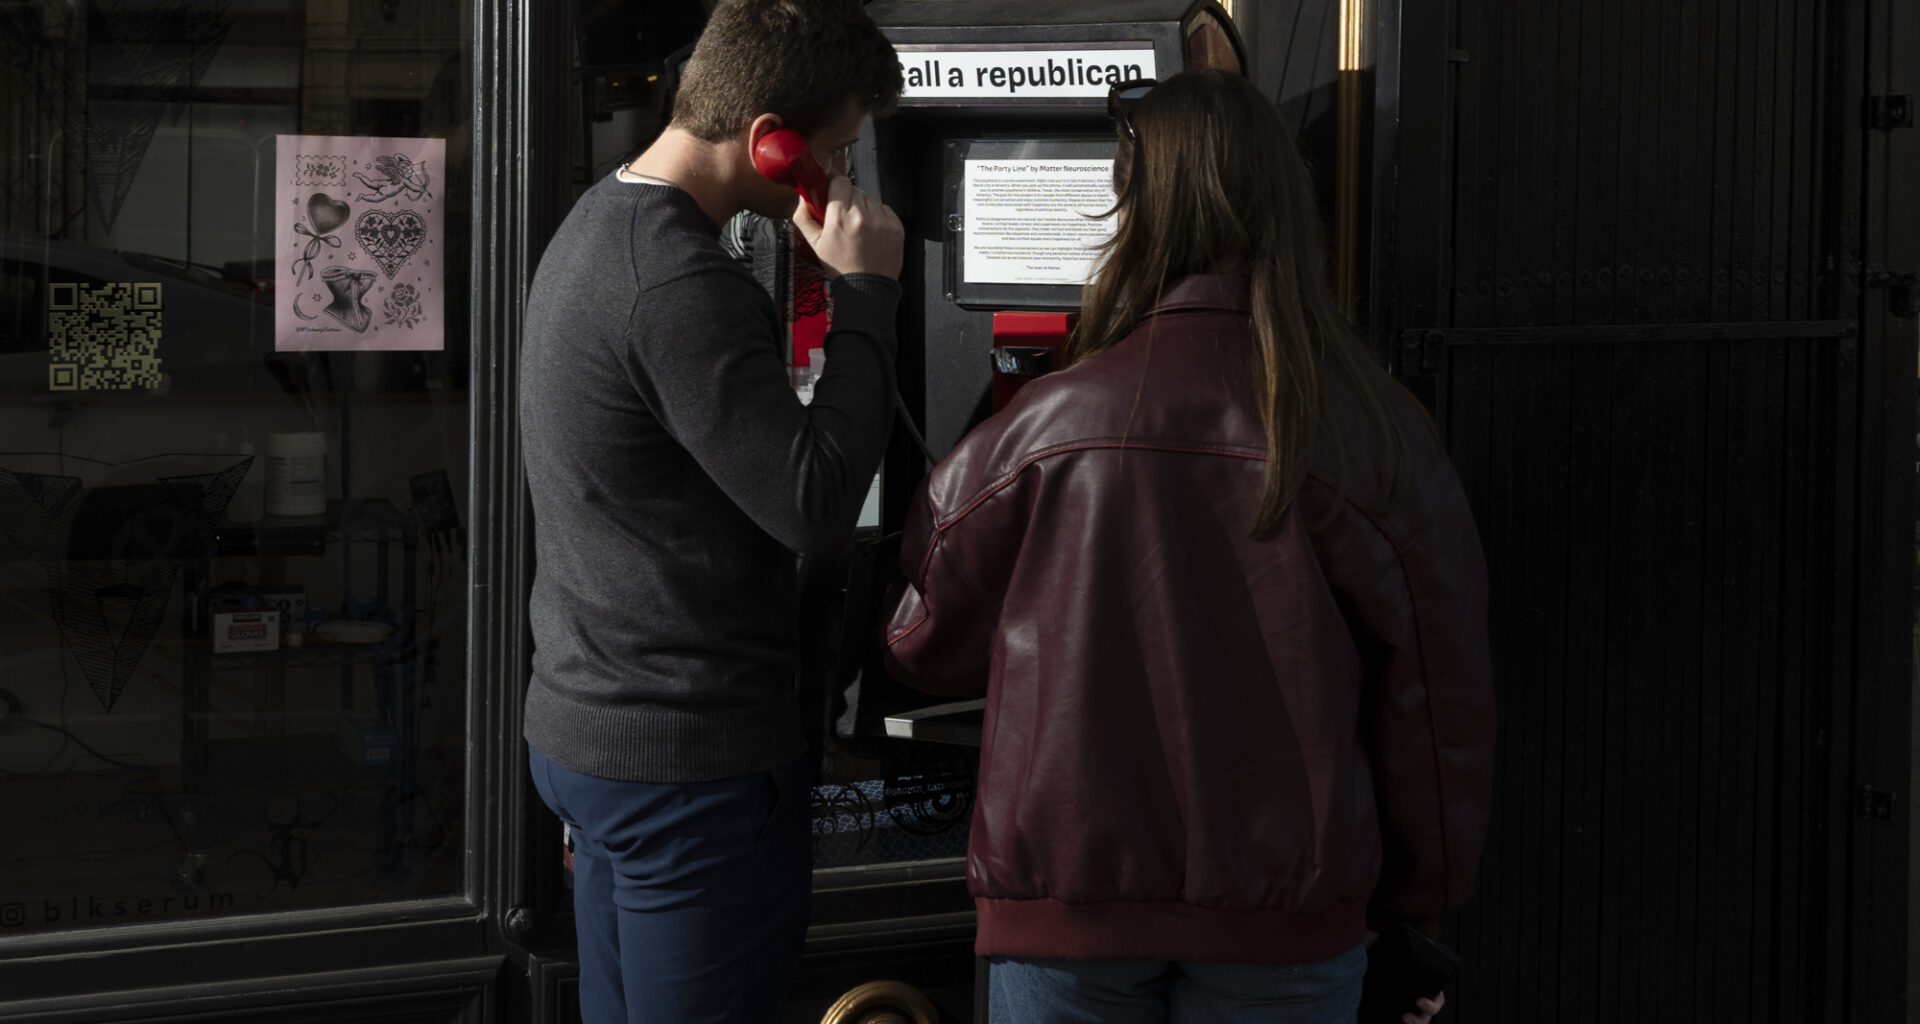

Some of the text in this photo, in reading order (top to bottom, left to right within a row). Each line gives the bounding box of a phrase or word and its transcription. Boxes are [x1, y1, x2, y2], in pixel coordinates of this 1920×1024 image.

[948, 66, 964, 87] a
[976, 58, 1142, 93] republican
[994, 165, 1011, 173] Party
[1030, 165, 1038, 173] by
[43, 891, 234, 922] blkserum
